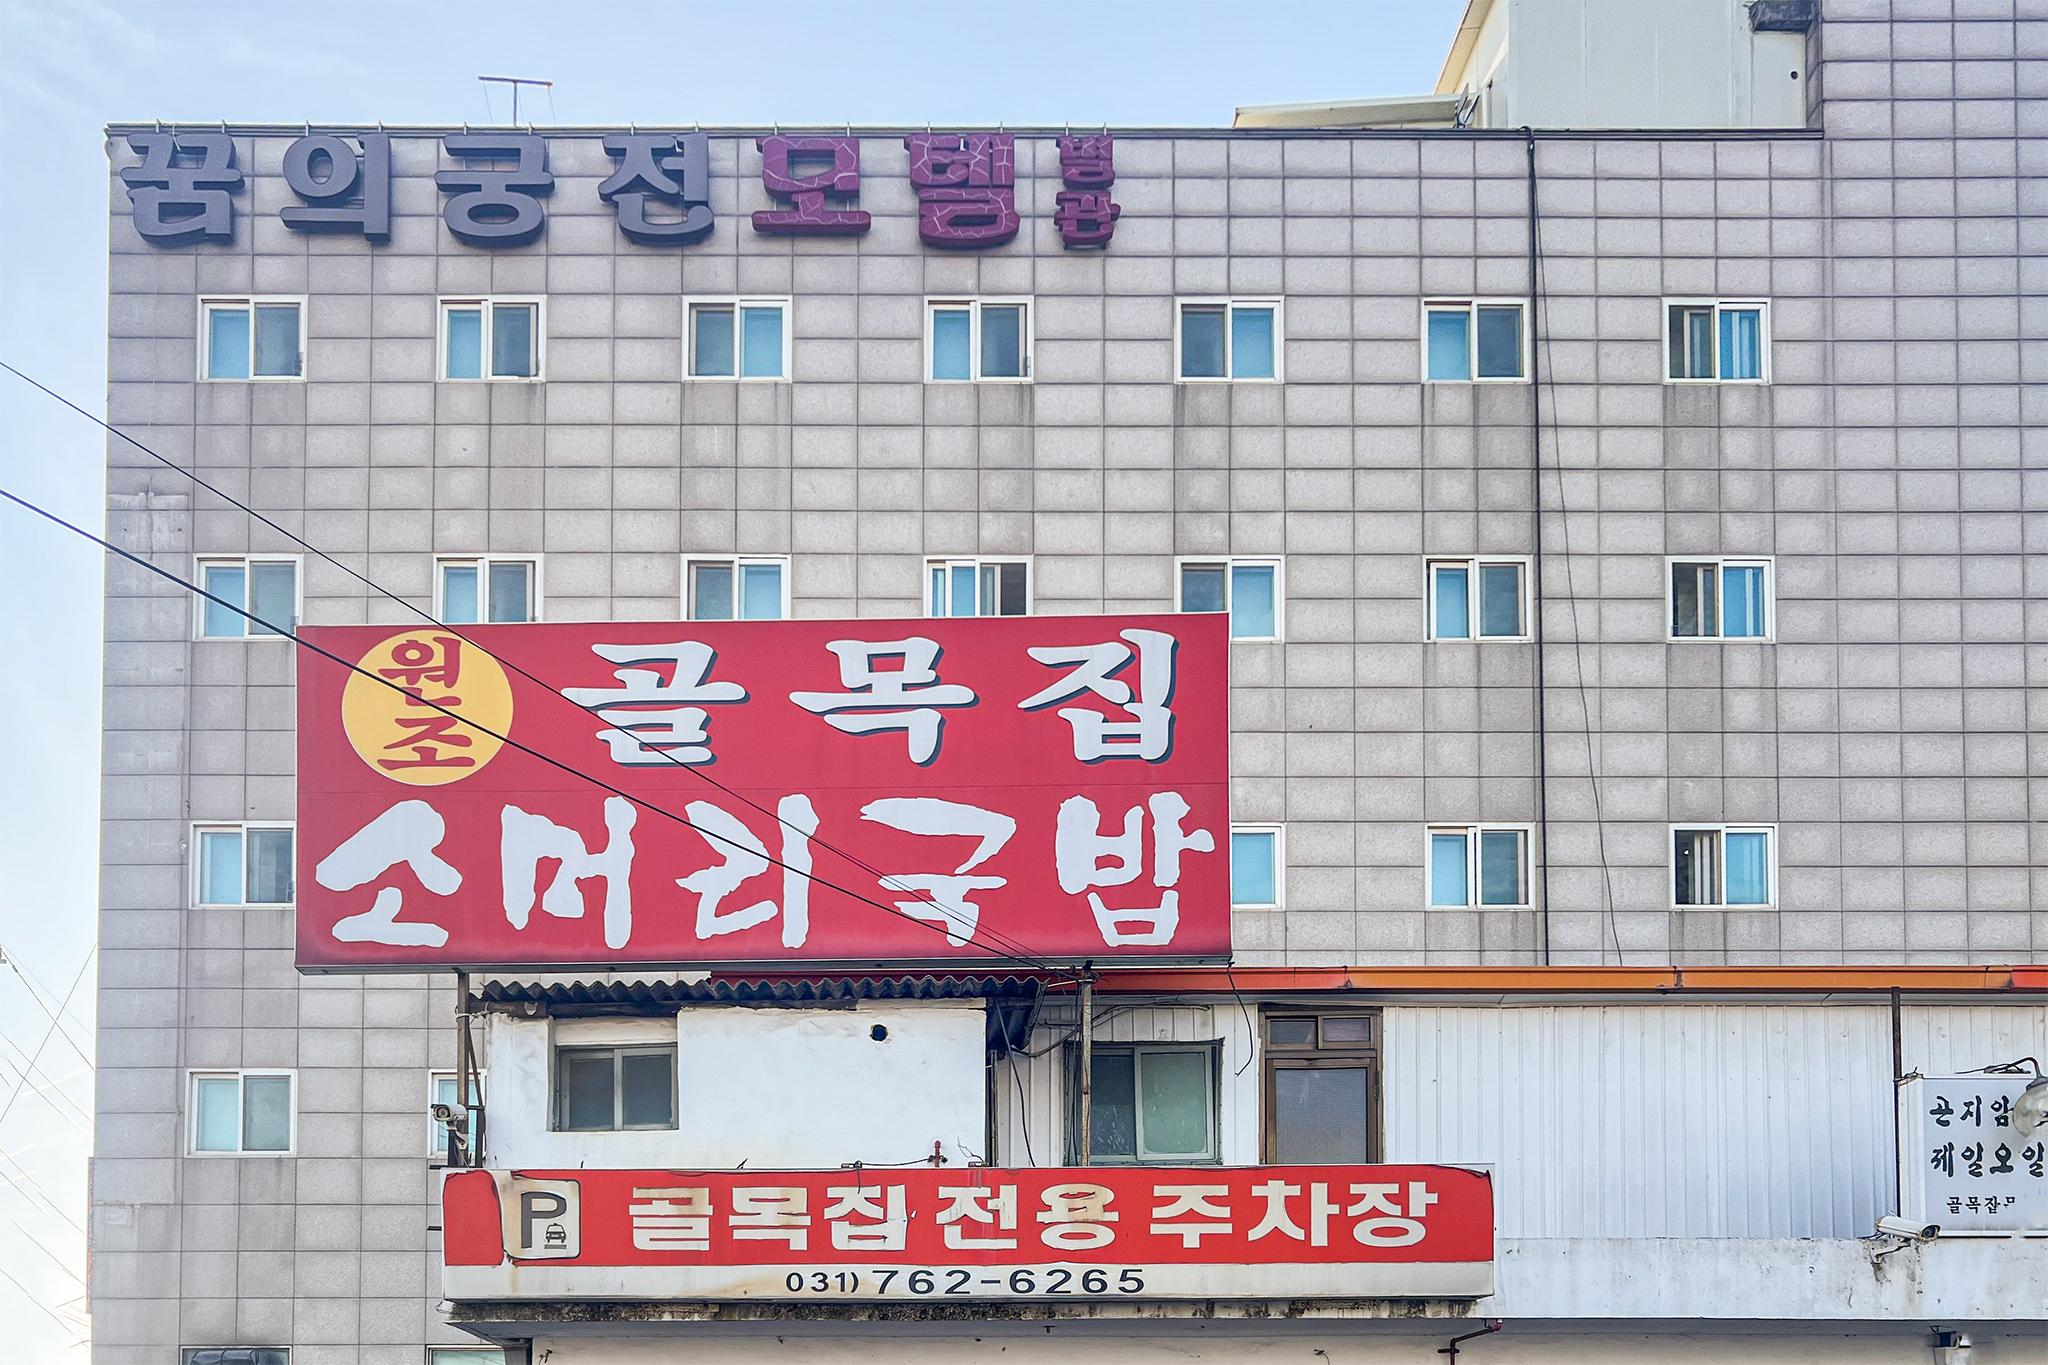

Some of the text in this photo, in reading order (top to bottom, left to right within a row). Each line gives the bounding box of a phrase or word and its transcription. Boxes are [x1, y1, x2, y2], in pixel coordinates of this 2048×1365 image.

[377, 636, 476, 771] 원조
[561, 628, 1178, 767] 골목집
[315, 790, 1216, 950] 소머리국밥
[1929, 1095, 2010, 1127] 곤지암
[1930, 1141, 2045, 1178] 제일오일
[519, 1191, 567, 1249] P
[629, 1180, 1439, 1251] 골목집 전용 주차장
